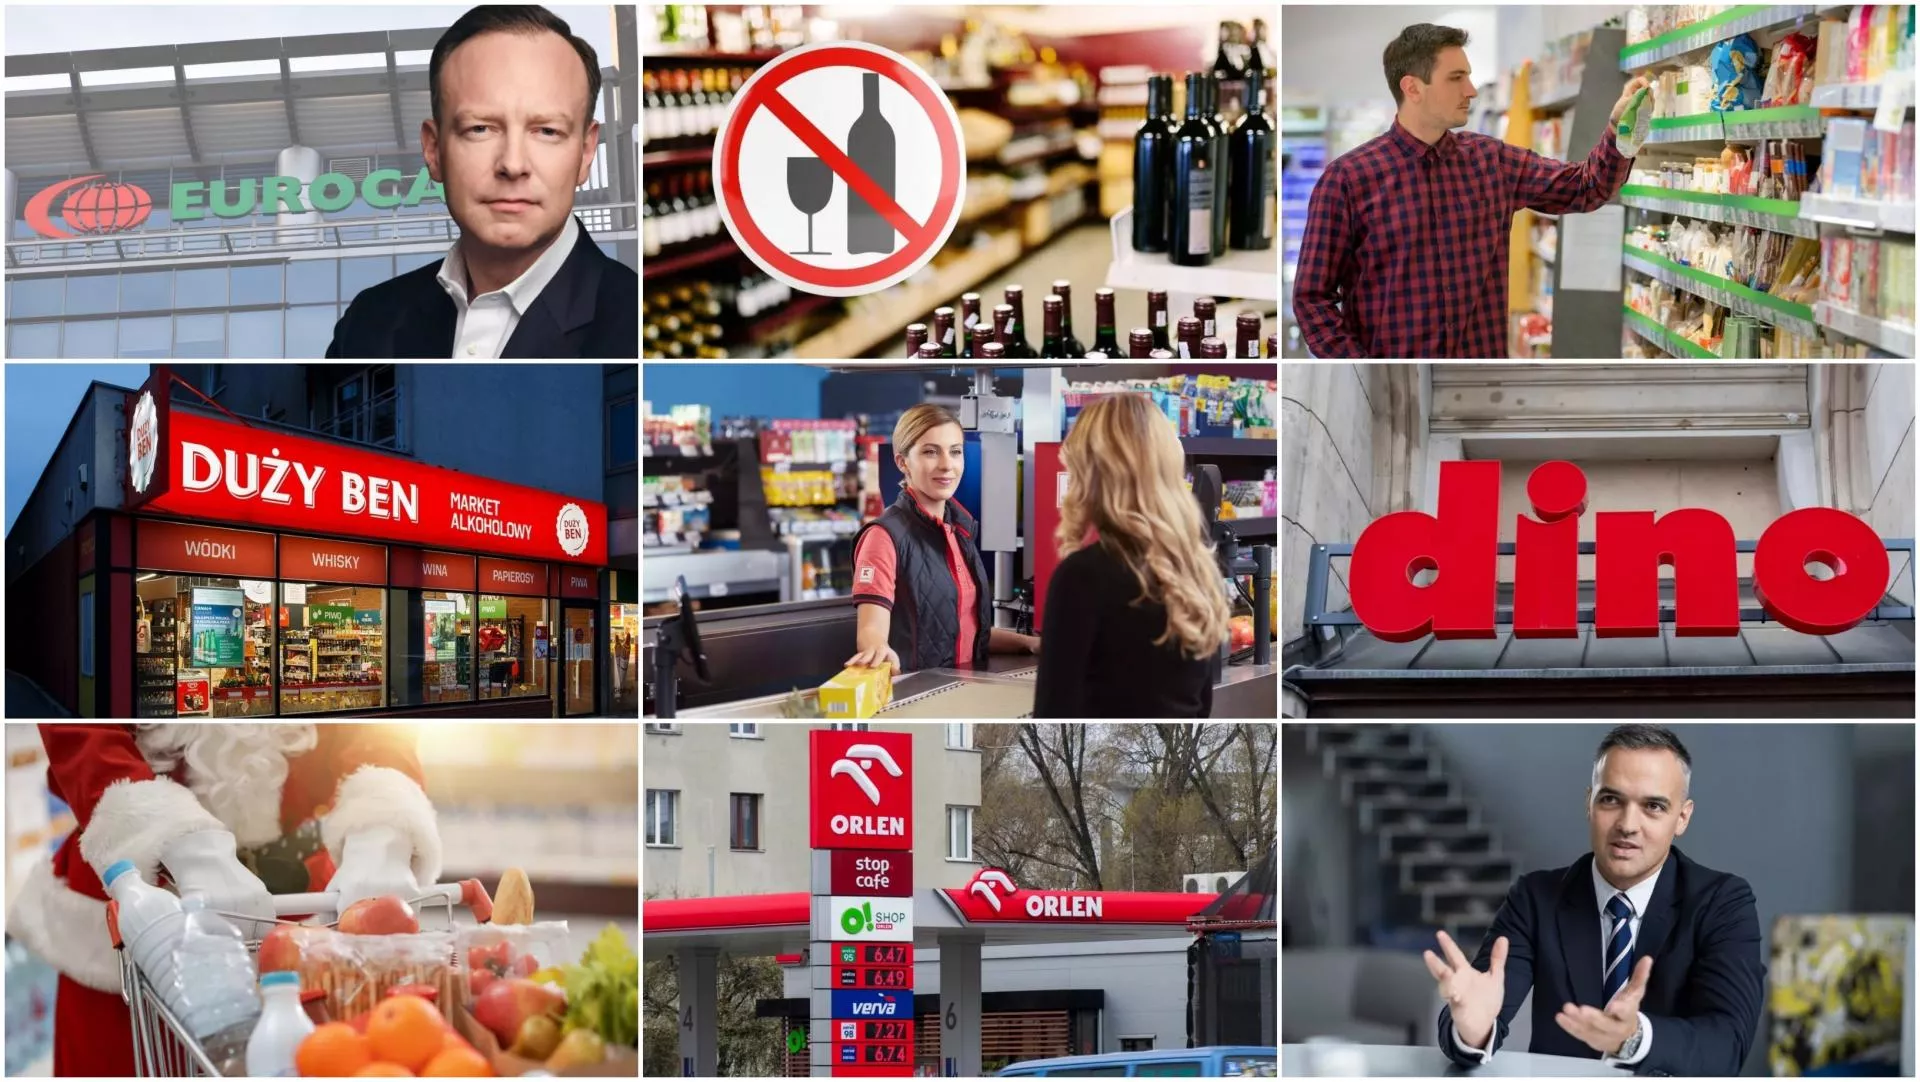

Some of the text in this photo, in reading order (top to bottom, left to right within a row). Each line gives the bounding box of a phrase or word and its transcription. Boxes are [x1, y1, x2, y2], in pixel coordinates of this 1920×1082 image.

[181, 441, 418, 524] DUŻY BEN
[450, 492, 500, 516] MARKET
[451, 512, 532, 540] ALKOHOLOWY
[564, 519, 581, 528] DUŻY
[565, 528, 582, 540] BEN
[184, 539, 236, 560] WÓDKI
[1349, 460, 1890, 643] dino
[312, 552, 360, 570] WHISKY
[422, 563, 447, 577] WINA
[493, 570, 534, 584] PAPIEROSY
[571, 576, 588, 589] PIWA
[324, 611, 342, 620] PIWO
[830, 814, 904, 836] ORLEN
[856, 856, 890, 875] stop
[856, 874, 890, 890] cafe
[1026, 894, 1103, 917] ORLEN
[875, 911, 905, 923] SHOP
[843, 953, 854, 962] 95
[874, 947, 905, 962] 6.47
[874, 970, 905, 985] 6.49
[852, 1002, 896, 1015] verva
[945, 1002, 957, 1030] 6
[682, 1005, 693, 1032] 4
[844, 1030, 854, 1038] 98
[874, 1023, 905, 1039] 7.27
[874, 1046, 905, 1062] 6.74
